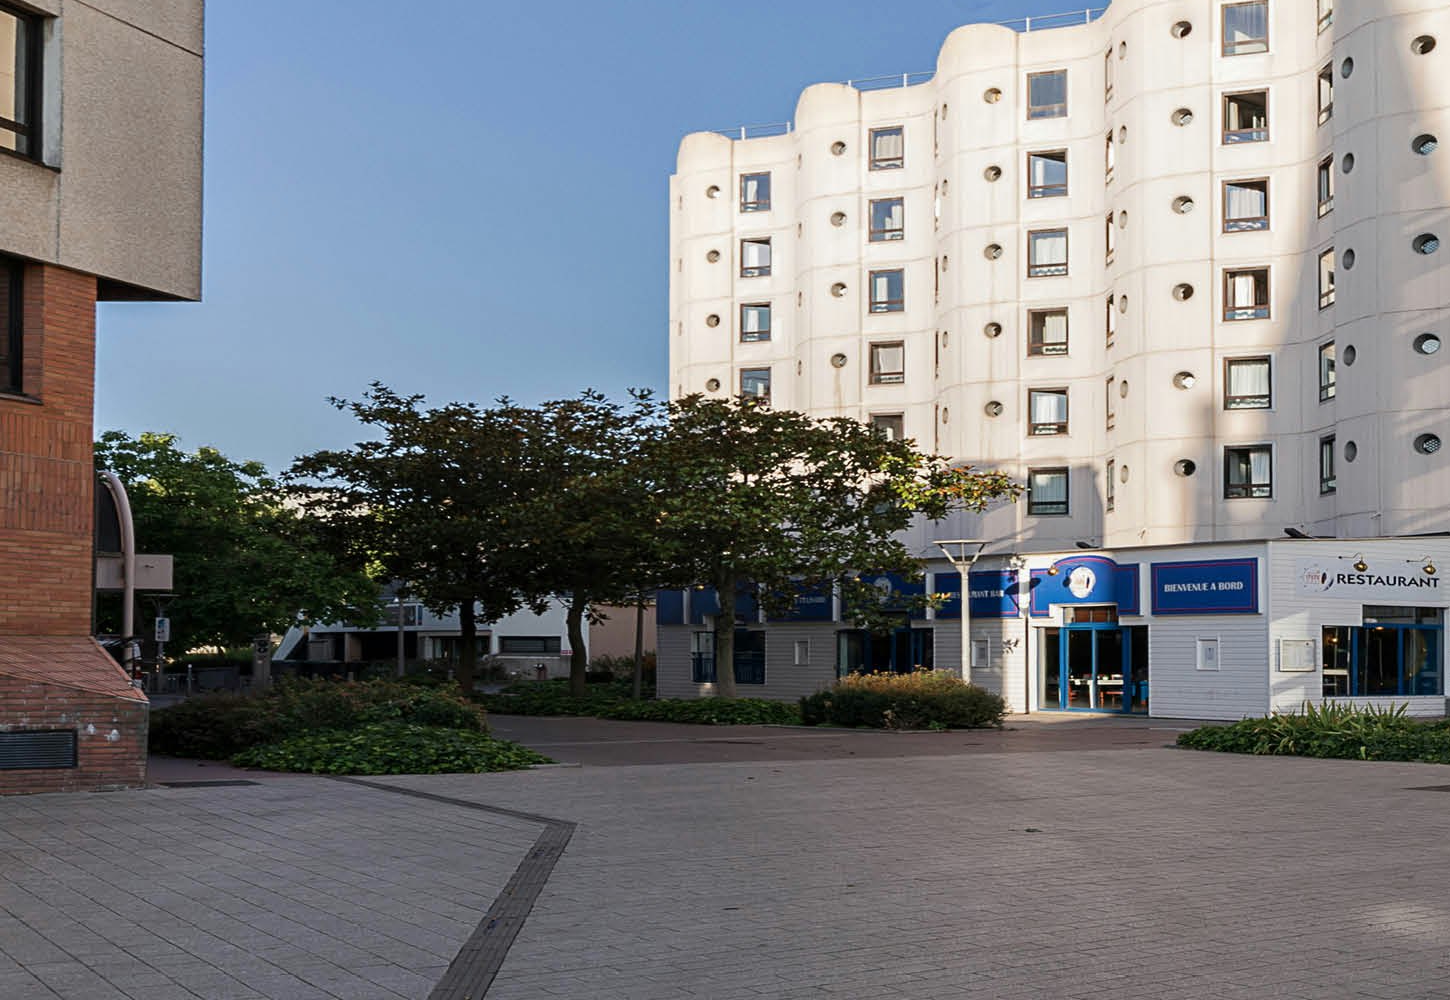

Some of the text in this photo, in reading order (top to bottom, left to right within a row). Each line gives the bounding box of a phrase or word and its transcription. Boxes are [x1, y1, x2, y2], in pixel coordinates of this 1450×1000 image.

[1164, 583, 1209, 592] BIENVENUE
[1218, 581, 1243, 591] BORD
[1336, 573, 1440, 588] RESTAURANT
